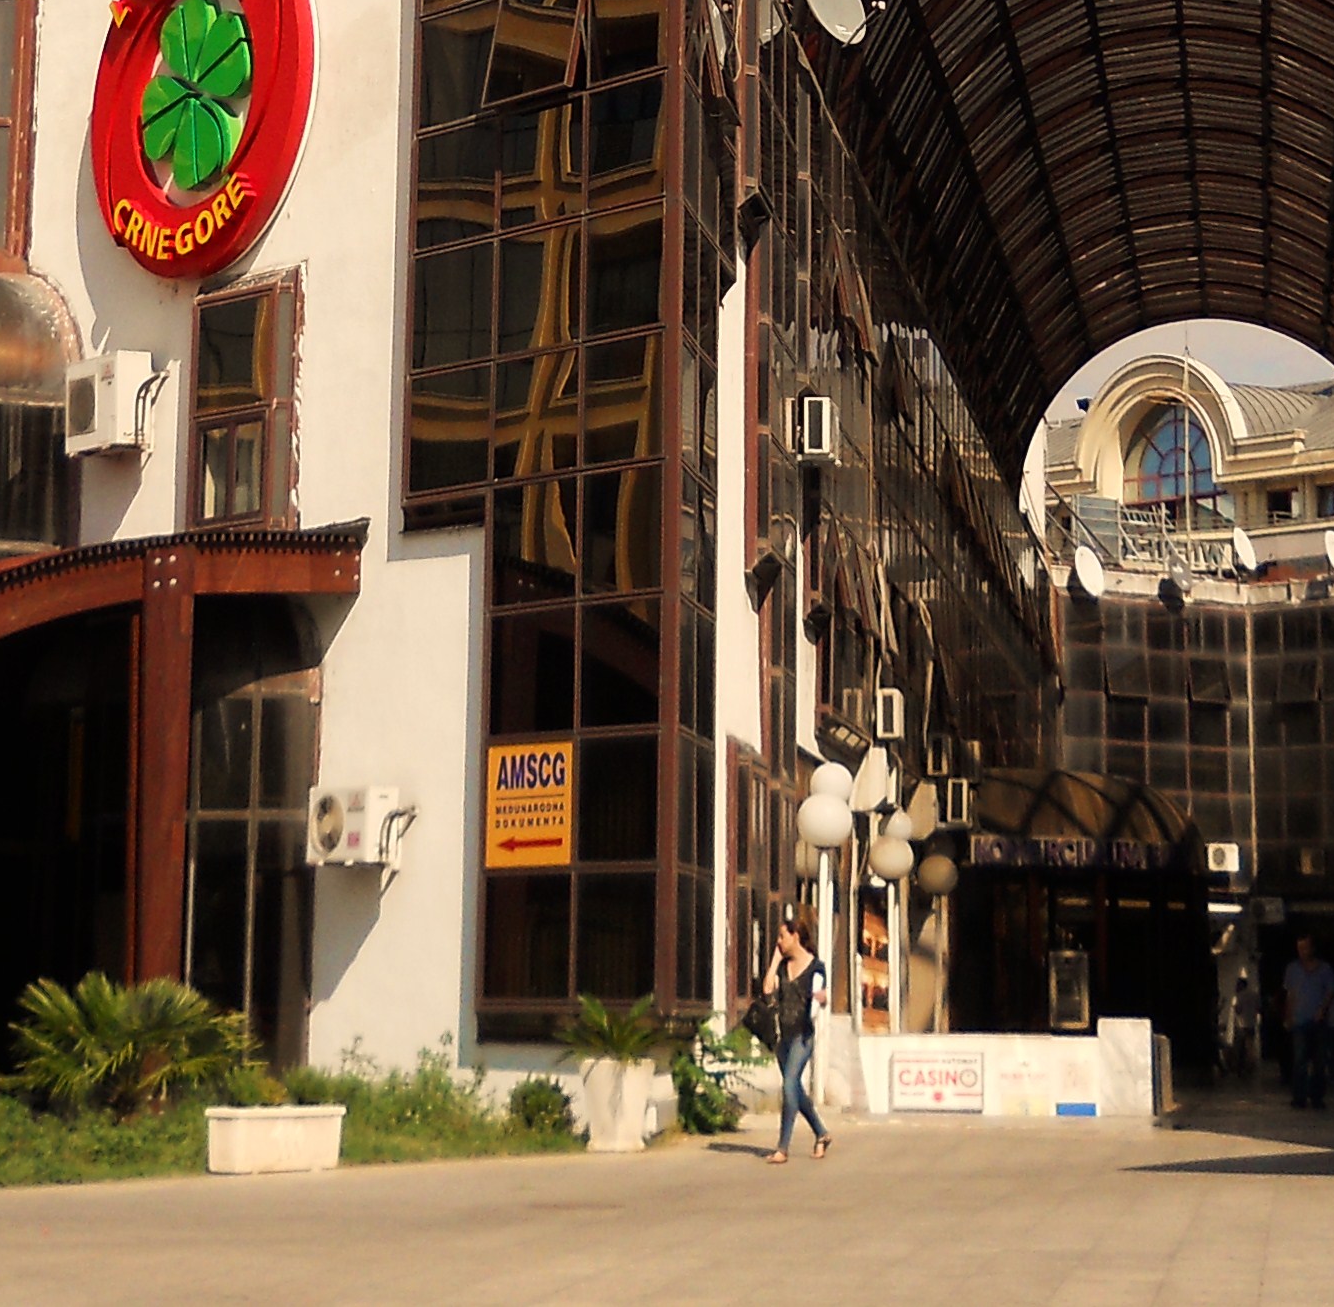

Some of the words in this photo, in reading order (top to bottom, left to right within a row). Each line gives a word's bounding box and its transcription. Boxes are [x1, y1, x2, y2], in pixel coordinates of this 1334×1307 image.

[113, 197, 173, 260] CRNE
[174, 173, 246, 256] GORE
[496, 752, 566, 791] AMSCG
[898, 1068, 979, 1088] CASINO
